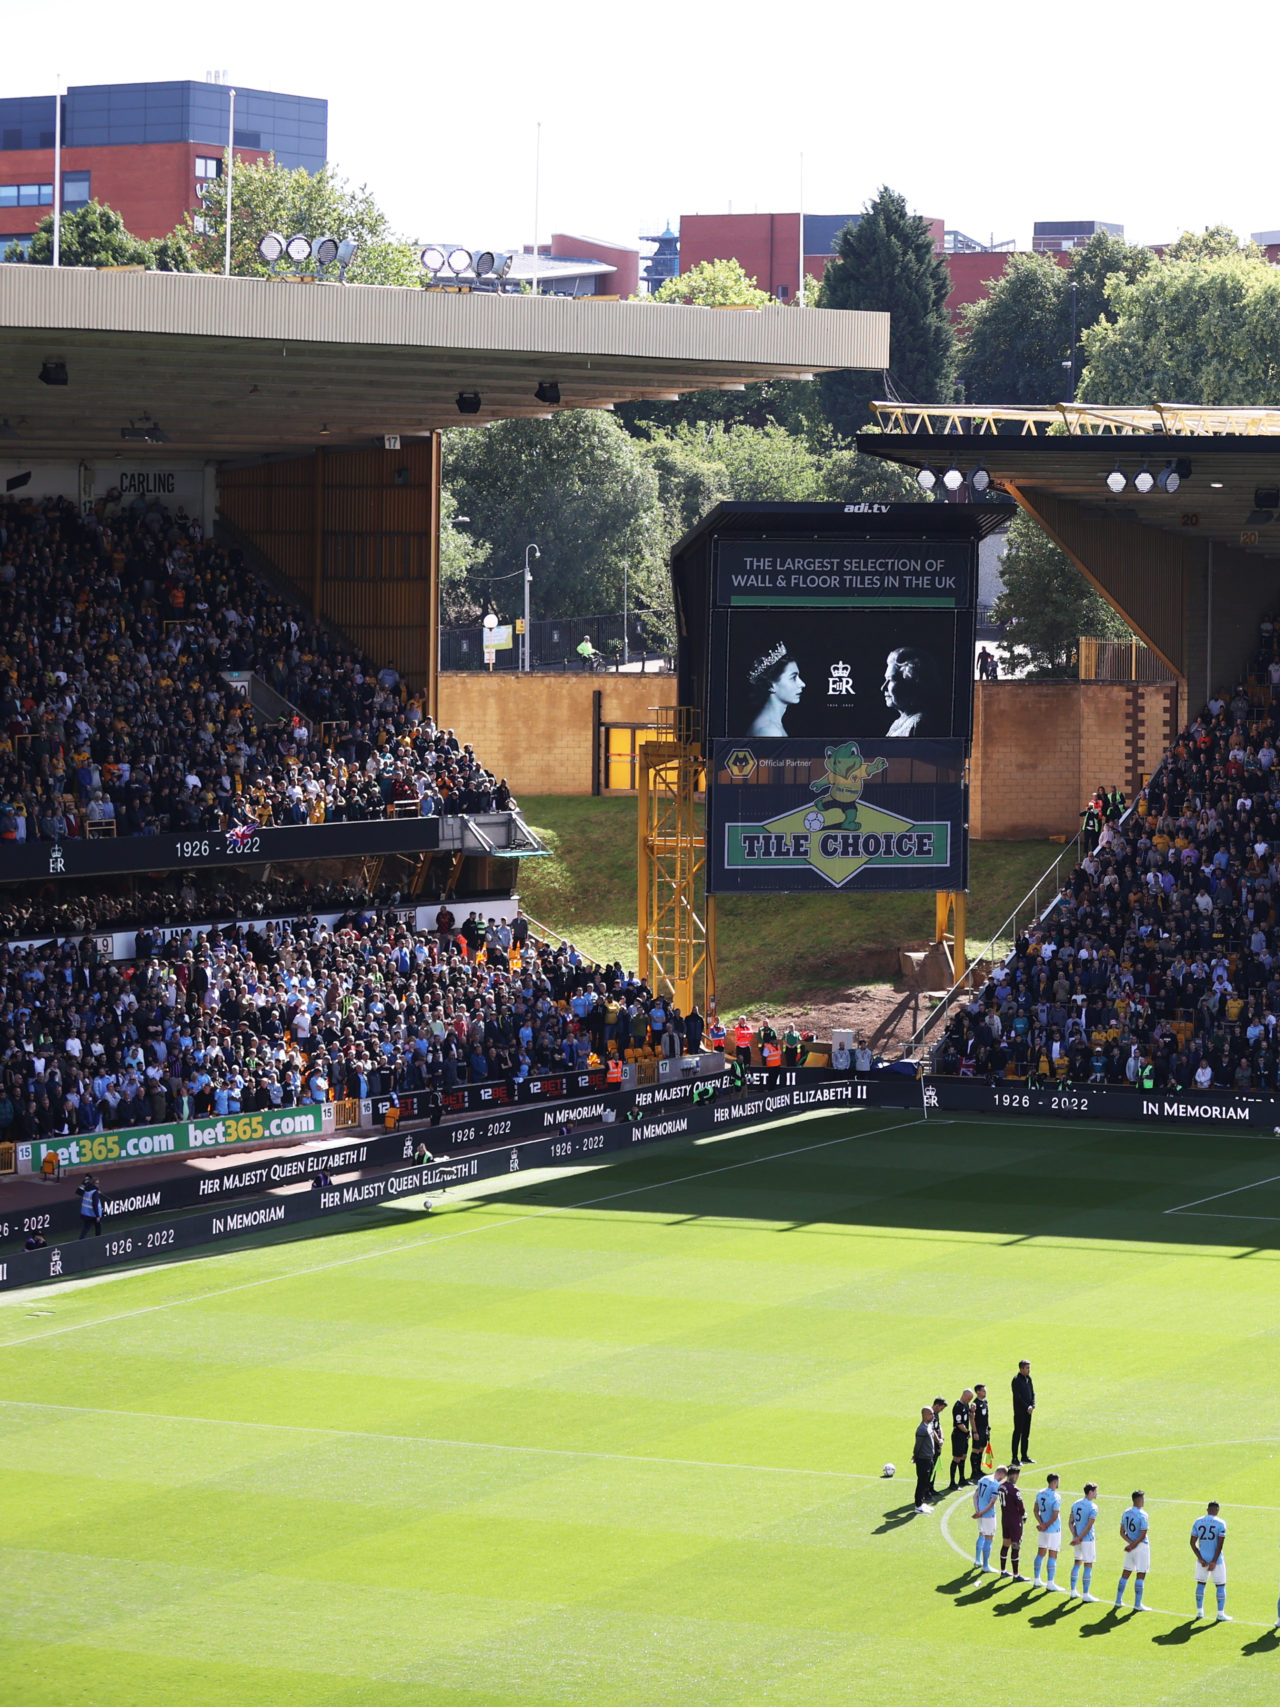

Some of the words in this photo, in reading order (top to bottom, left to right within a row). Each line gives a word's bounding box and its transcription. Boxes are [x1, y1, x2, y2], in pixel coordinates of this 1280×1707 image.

[386, 436, 398, 448] 17
[120, 472, 175, 493] CARLING
[844, 503, 890, 513] adi.tv
[1182, 514, 1198, 526] 20
[1241, 532, 1257, 544] 20
[744, 558, 773, 570] THE
[777, 559, 840, 571] LARGEST
[843, 559, 920, 571] SELECTION
[925, 560, 945, 572] OF
[732, 575, 773, 587] WALL
[776, 575, 787, 587] &
[791, 575, 840, 588] FLOOR
[843, 576, 880, 588] TILES
[884, 576, 899, 588] IN
[903, 576, 931, 588] THE
[935, 577, 956, 588] UK
[176, 840, 210, 857] 1926
[742, 833, 810, 858] TILE
[820, 833, 934, 858] CHOICE
[636, 1092, 653, 1107] HER
[654, 1084, 691, 1103] MAJESTY
[785, 1072, 796, 1085] II
[714, 1107, 729, 1122] HER
[731, 1102, 763, 1119] MAJESTY
[765, 1094, 790, 1112] QUEEN
[793, 1087, 852, 1105] ELIZABETH
[857, 1086, 867, 1099] II
[994, 1095, 1030, 1108] 1926
[1051, 1097, 1089, 1110] 2022
[1143, 1101, 1159, 1116] IN
[1164, 1103, 1250, 1120] MEMORIAM
[323, 1108, 332, 1119] 15
[544, 1112, 554, 1126] IN
[188, 1113, 314, 1147] bet365.com
[451, 1127, 475, 1143] 1926
[487, 1121, 511, 1137] 2022
[632, 1127, 642, 1141] IN
[643, 1118, 688, 1138] MEMORIAM
[20, 1145, 31, 1158] 15
[551, 1142, 572, 1157] 1926
[582, 1135, 604, 1151] 2022
[200, 1177, 220, 1195] HER
[223, 1168, 268, 1191] MAJESTY
[270, 1161, 305, 1181] QUEEN
[360, 1147, 367, 1162] II
[321, 1191, 341, 1208] HER
[343, 1182, 386, 1204] MAJESTY
[387, 1175, 420, 1195] QUEEN
[471, 1160, 478, 1174] II
[104, 1192, 161, 1216] MEMORIAM
[24, 1214, 50, 1232] 2022
[212, 1218, 224, 1234] IN
[227, 1205, 285, 1231] MEMORIAM
[105, 1239, 132, 1257] 1926
[147, 1230, 175, 1247] 2022
[979, 1482, 988, 1498] 17
[1040, 1497, 1046, 1512] 3
[1075, 1507, 1082, 1522] 5
[1125, 1516, 1136, 1533] 16
[1198, 1525, 1216, 1541] 25
